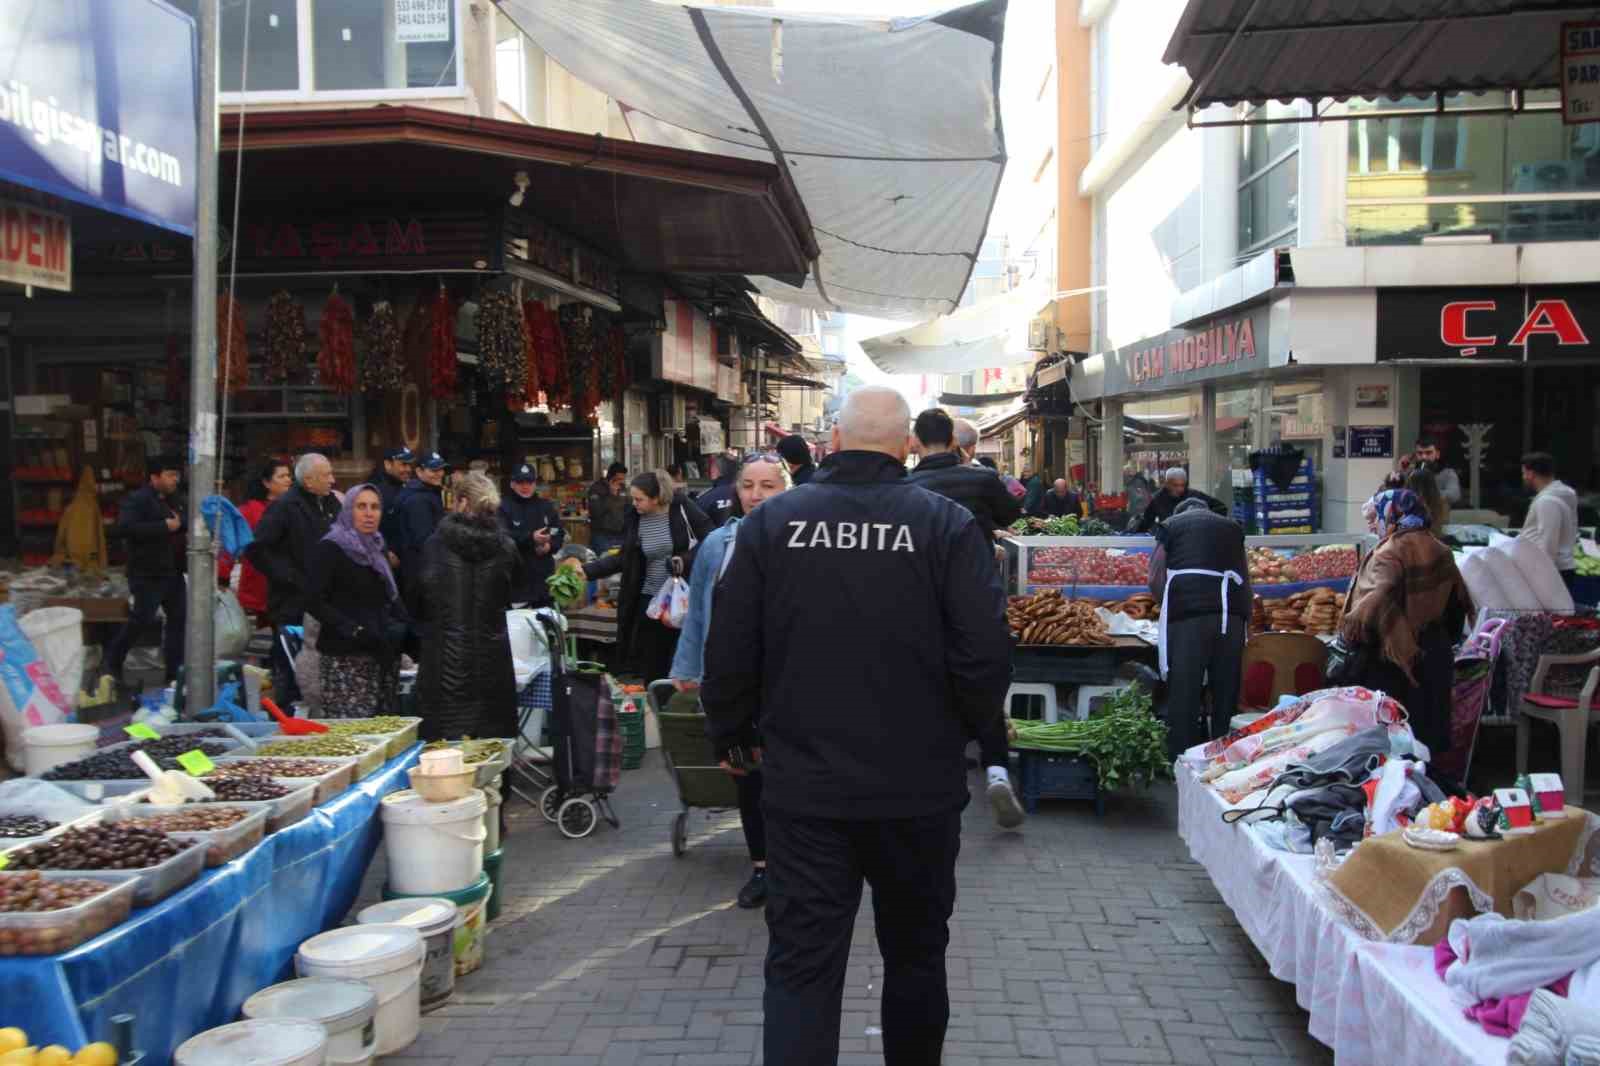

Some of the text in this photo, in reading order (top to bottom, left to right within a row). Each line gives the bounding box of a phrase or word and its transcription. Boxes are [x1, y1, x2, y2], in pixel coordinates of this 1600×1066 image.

[0, 206, 66, 272] DEM
[1134, 318, 1256, 386] ÇAM MOBİLYA
[1441, 300, 1589, 356] ÇA
[787, 520, 915, 552] ZABITA
